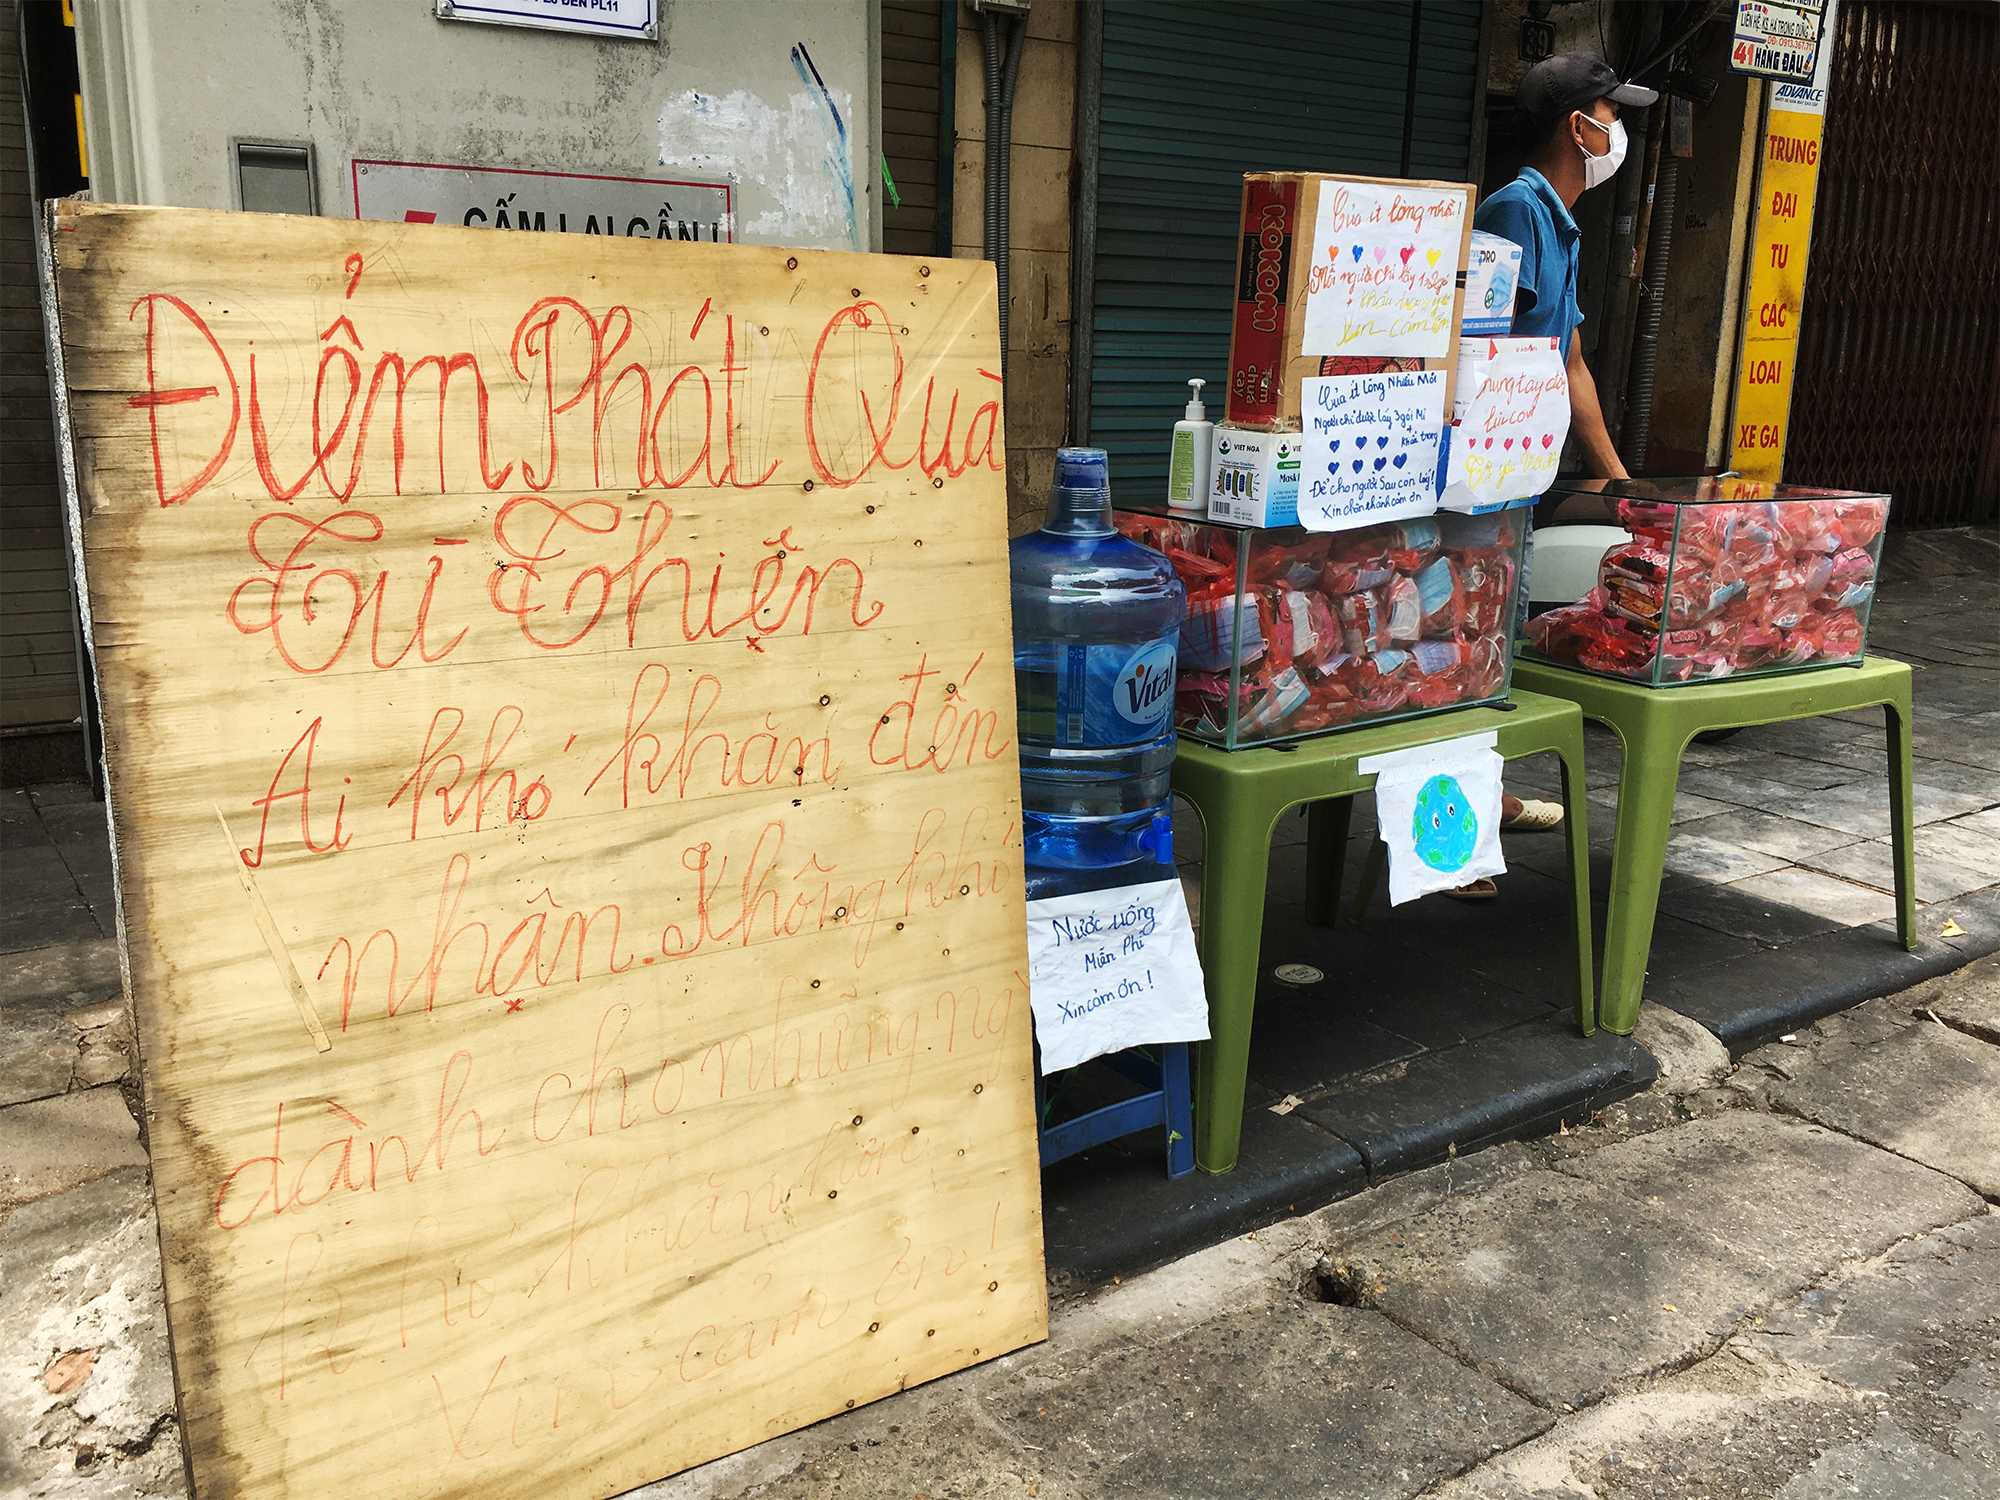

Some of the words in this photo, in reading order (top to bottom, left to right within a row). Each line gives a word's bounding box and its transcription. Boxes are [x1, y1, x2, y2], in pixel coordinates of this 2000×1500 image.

[1734, 42, 1754, 65] 41
[1755, 45, 1780, 70] HÀNG
[1782, 51, 1804, 75] ĐẬU
[1775, 85, 1824, 101] ADVANCE
[1769, 135, 1817, 165] TRUNG
[1772, 191, 1798, 223] ĐẠI
[1253, 204, 1287, 333] KOKOMI
[1771, 244, 1789, 269] TU
[1760, 298, 1787, 327] CÁC
[121, 251, 514, 508] Điểm
[510, 295, 780, 493] Phát
[805, 300, 1006, 490] Quà
[1233, 369, 1246, 398] cay
[1749, 360, 1782, 384] LOAI
[1738, 425, 1757, 448] XE
[1760, 425, 1778, 448] GA
[1124, 656, 1174, 713] Vital
[240, 716, 353, 867] Ai
[584, 664, 844, 809] khăn
[868, 652, 1010, 773] đến
[662, 819, 886, 968] Không
[1052, 910, 1103, 947] Nước
[1108, 897, 1156, 936] uống
[1057, 1000, 1086, 1025] Xin
[214, 1050, 507, 1231] dành
[532, 1002, 686, 1145] cho
